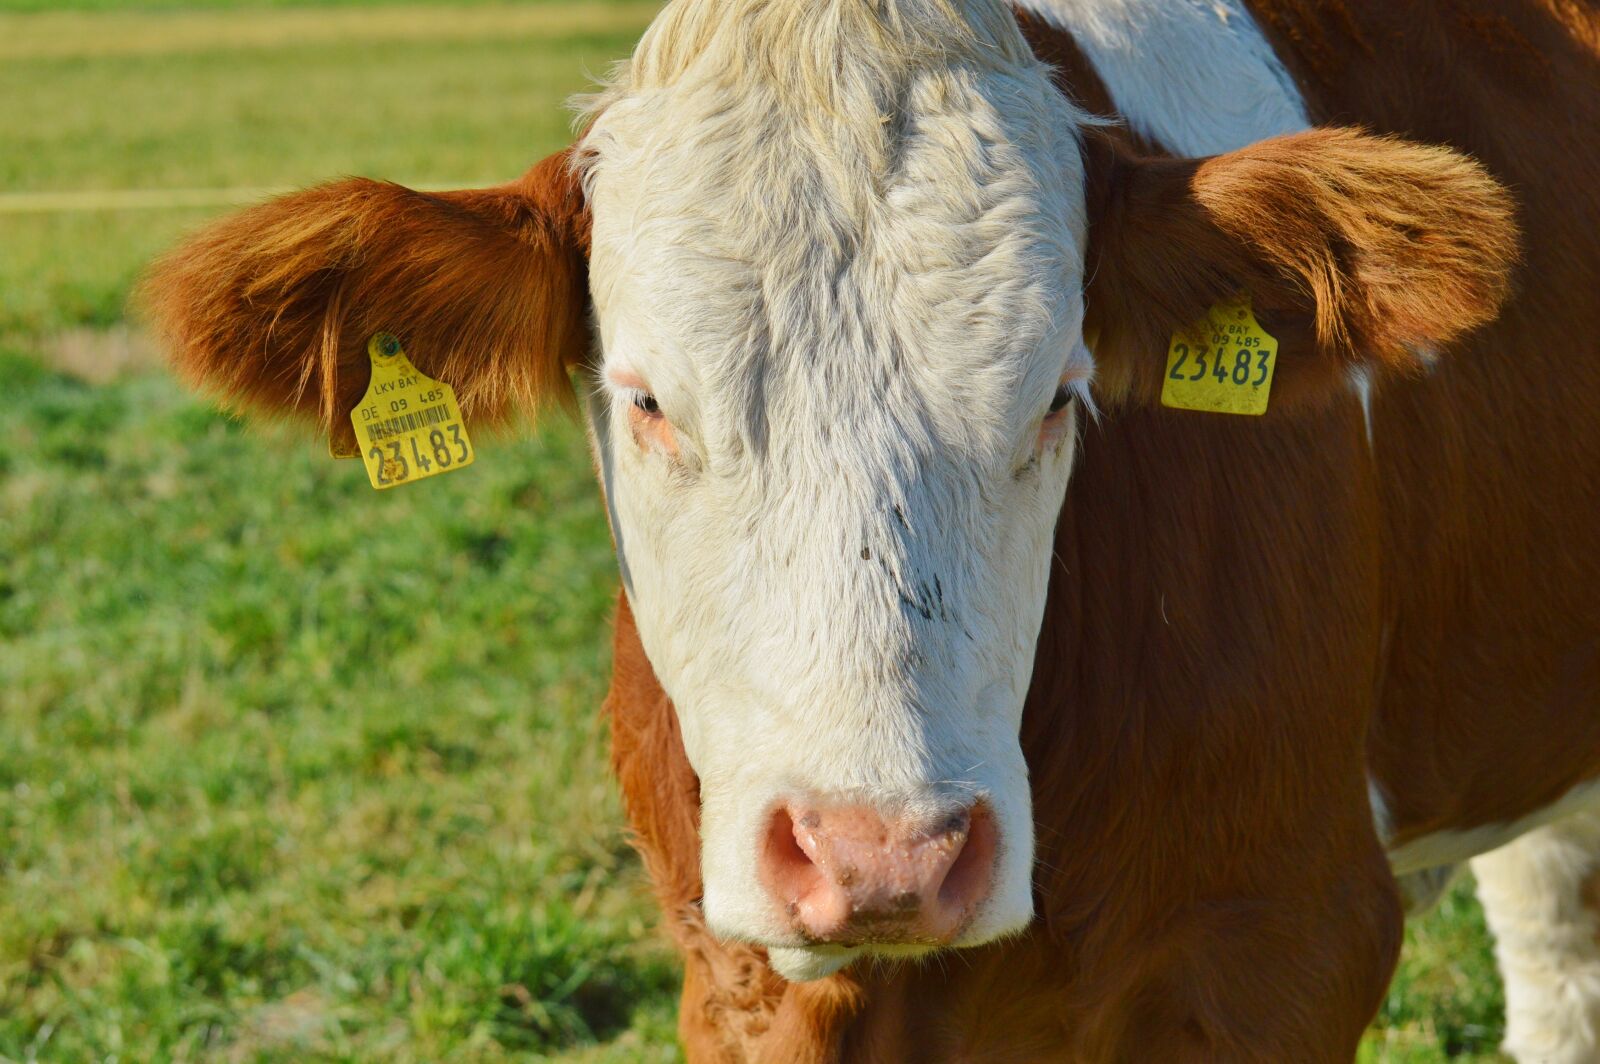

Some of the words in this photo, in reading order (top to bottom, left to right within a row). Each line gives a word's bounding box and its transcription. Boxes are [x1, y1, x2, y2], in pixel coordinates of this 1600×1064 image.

[1212, 334, 1230, 345] 09
[1235, 336, 1260, 348] 485
[1169, 343, 1271, 386] 23483
[374, 381, 395, 396] LKV
[399, 374, 419, 389] BAY
[361, 406, 380, 421] DE
[390, 398, 408, 413] 09
[419, 388, 444, 404] 485
[369, 423, 468, 485] 23483
